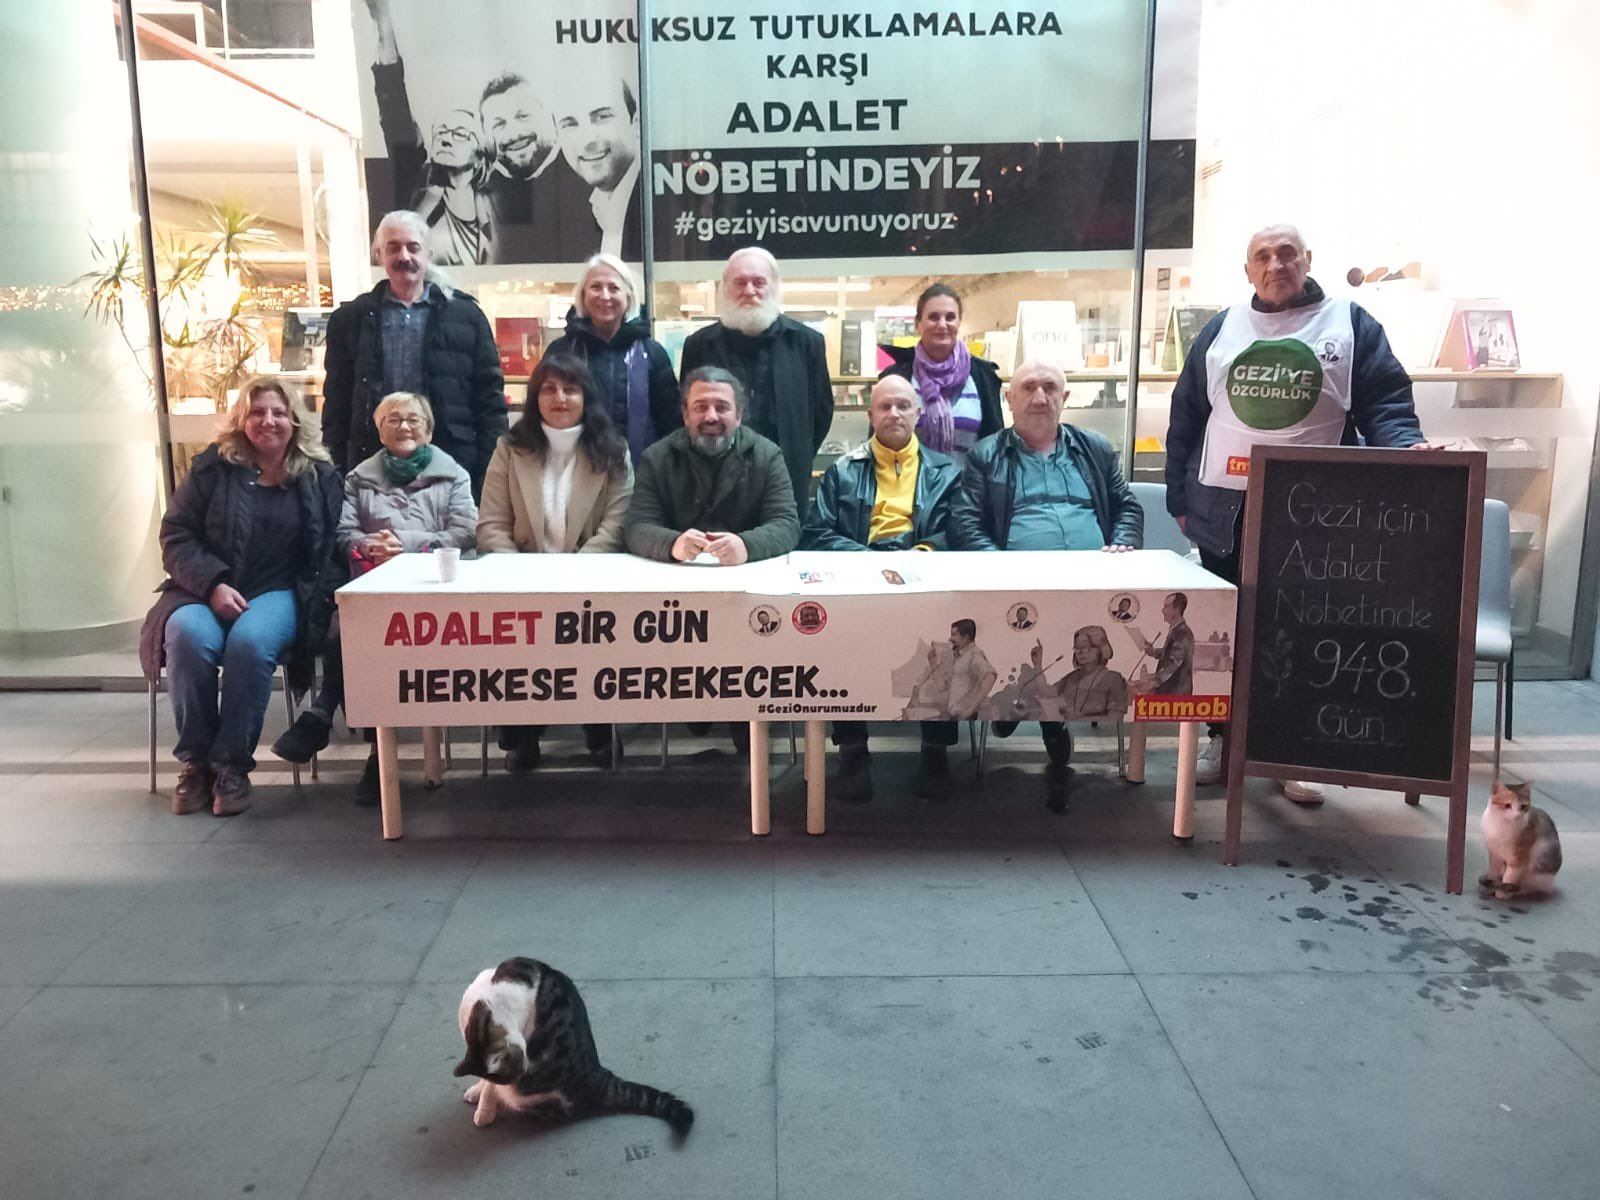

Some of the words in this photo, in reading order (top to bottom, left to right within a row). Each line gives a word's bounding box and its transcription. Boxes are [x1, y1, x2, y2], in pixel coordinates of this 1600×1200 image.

[750, 11, 1063, 40] TUTUKLAMALARA
[767, 53, 868, 86] KARŞI
[726, 99, 908, 134] ADALET
[653, 145, 981, 195] NÖBETİNDEYİZ
[674, 208, 955, 241] #geziyisavunuyoruz
[1231, 383, 1312, 401] ÖZGÜRLÜK
[1287, 482, 1361, 527] Gezi
[1377, 501, 1430, 536] için
[1278, 540, 1390, 583] Adalet
[384, 612, 542, 646] ADALET
[555, 600, 616, 643] BİR
[633, 600, 709, 643] GÜN
[399, 667, 578, 704] HERKESE
[594, 665, 849, 701] GEREKECEK...
[1309, 639, 1417, 699] 948.
[758, 702, 878, 714] #GeziOnurumuzdur
[1137, 697, 1228, 716] tmmob
[1317, 704, 1385, 742] Gün
